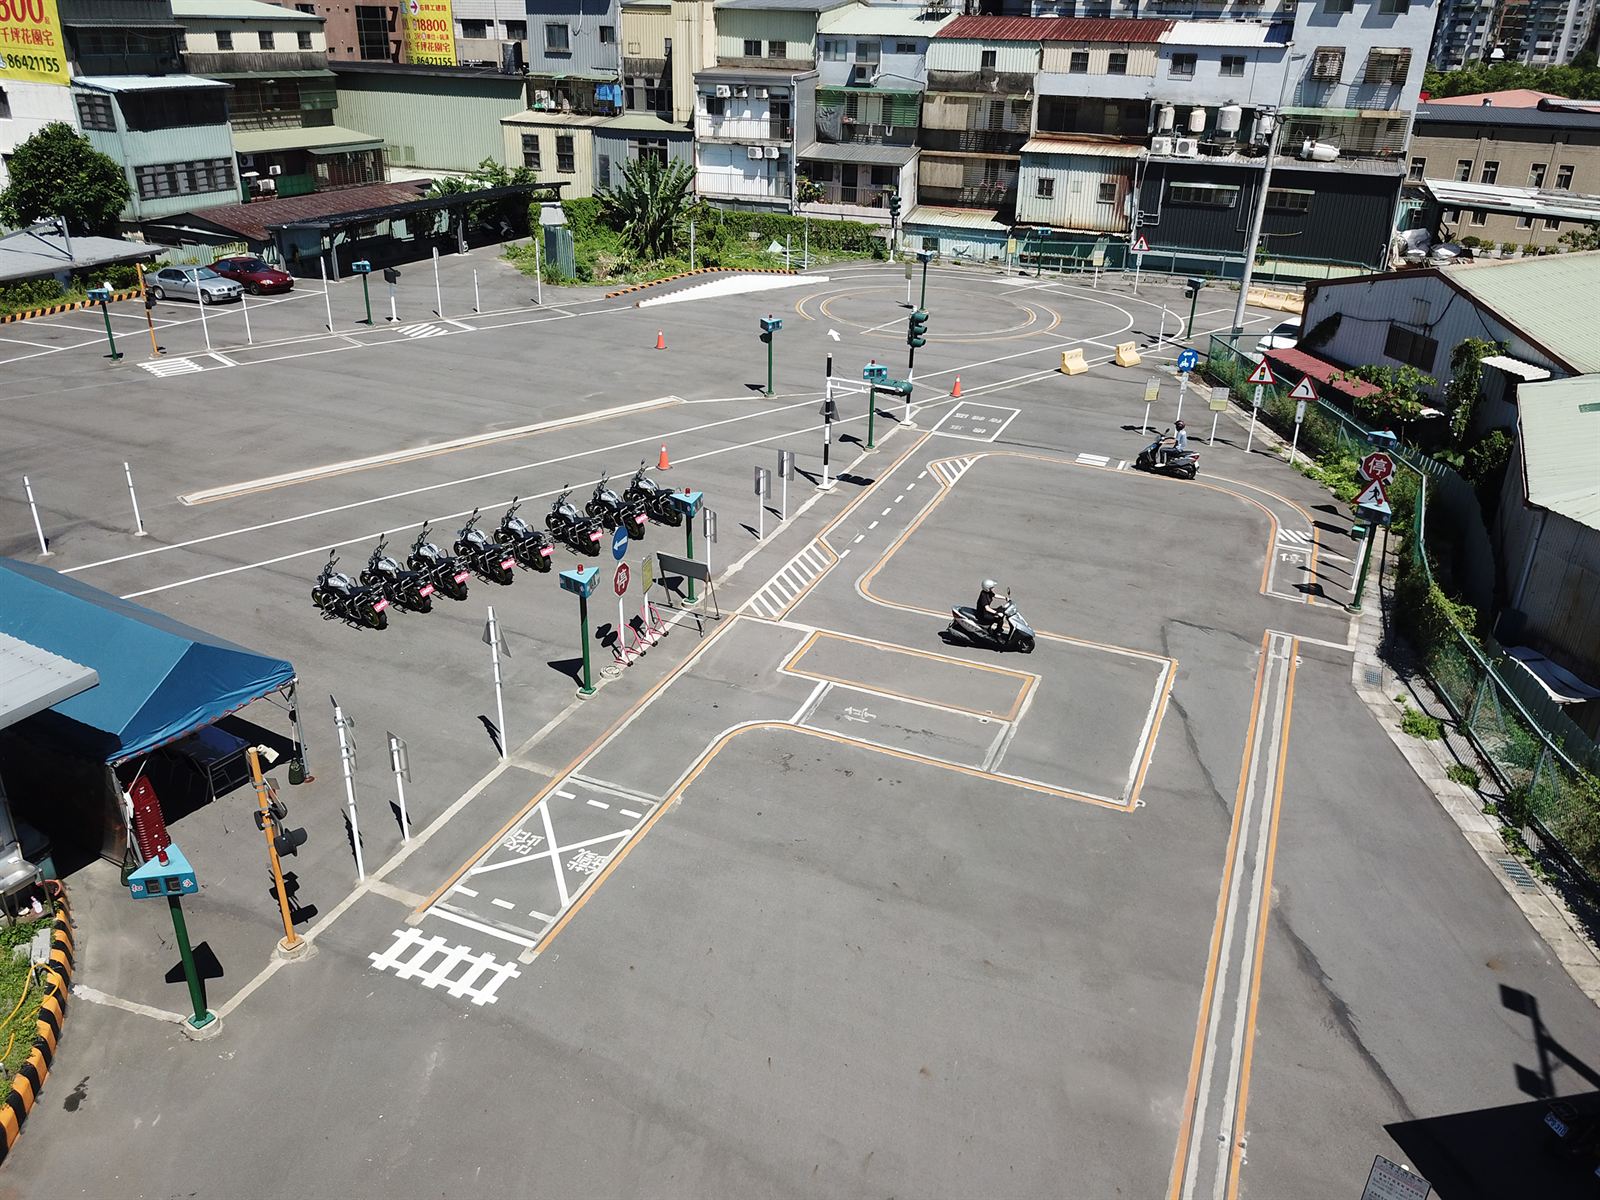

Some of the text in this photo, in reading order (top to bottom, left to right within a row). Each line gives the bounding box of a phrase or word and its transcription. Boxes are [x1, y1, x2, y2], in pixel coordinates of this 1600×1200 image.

[7, 53, 60, 73] 86421155
[416, 56, 452, 66] 86421155
[1368, 457, 1388, 476] 停
[616, 567, 627, 592] 停
[503, 829, 545, 855] 路
